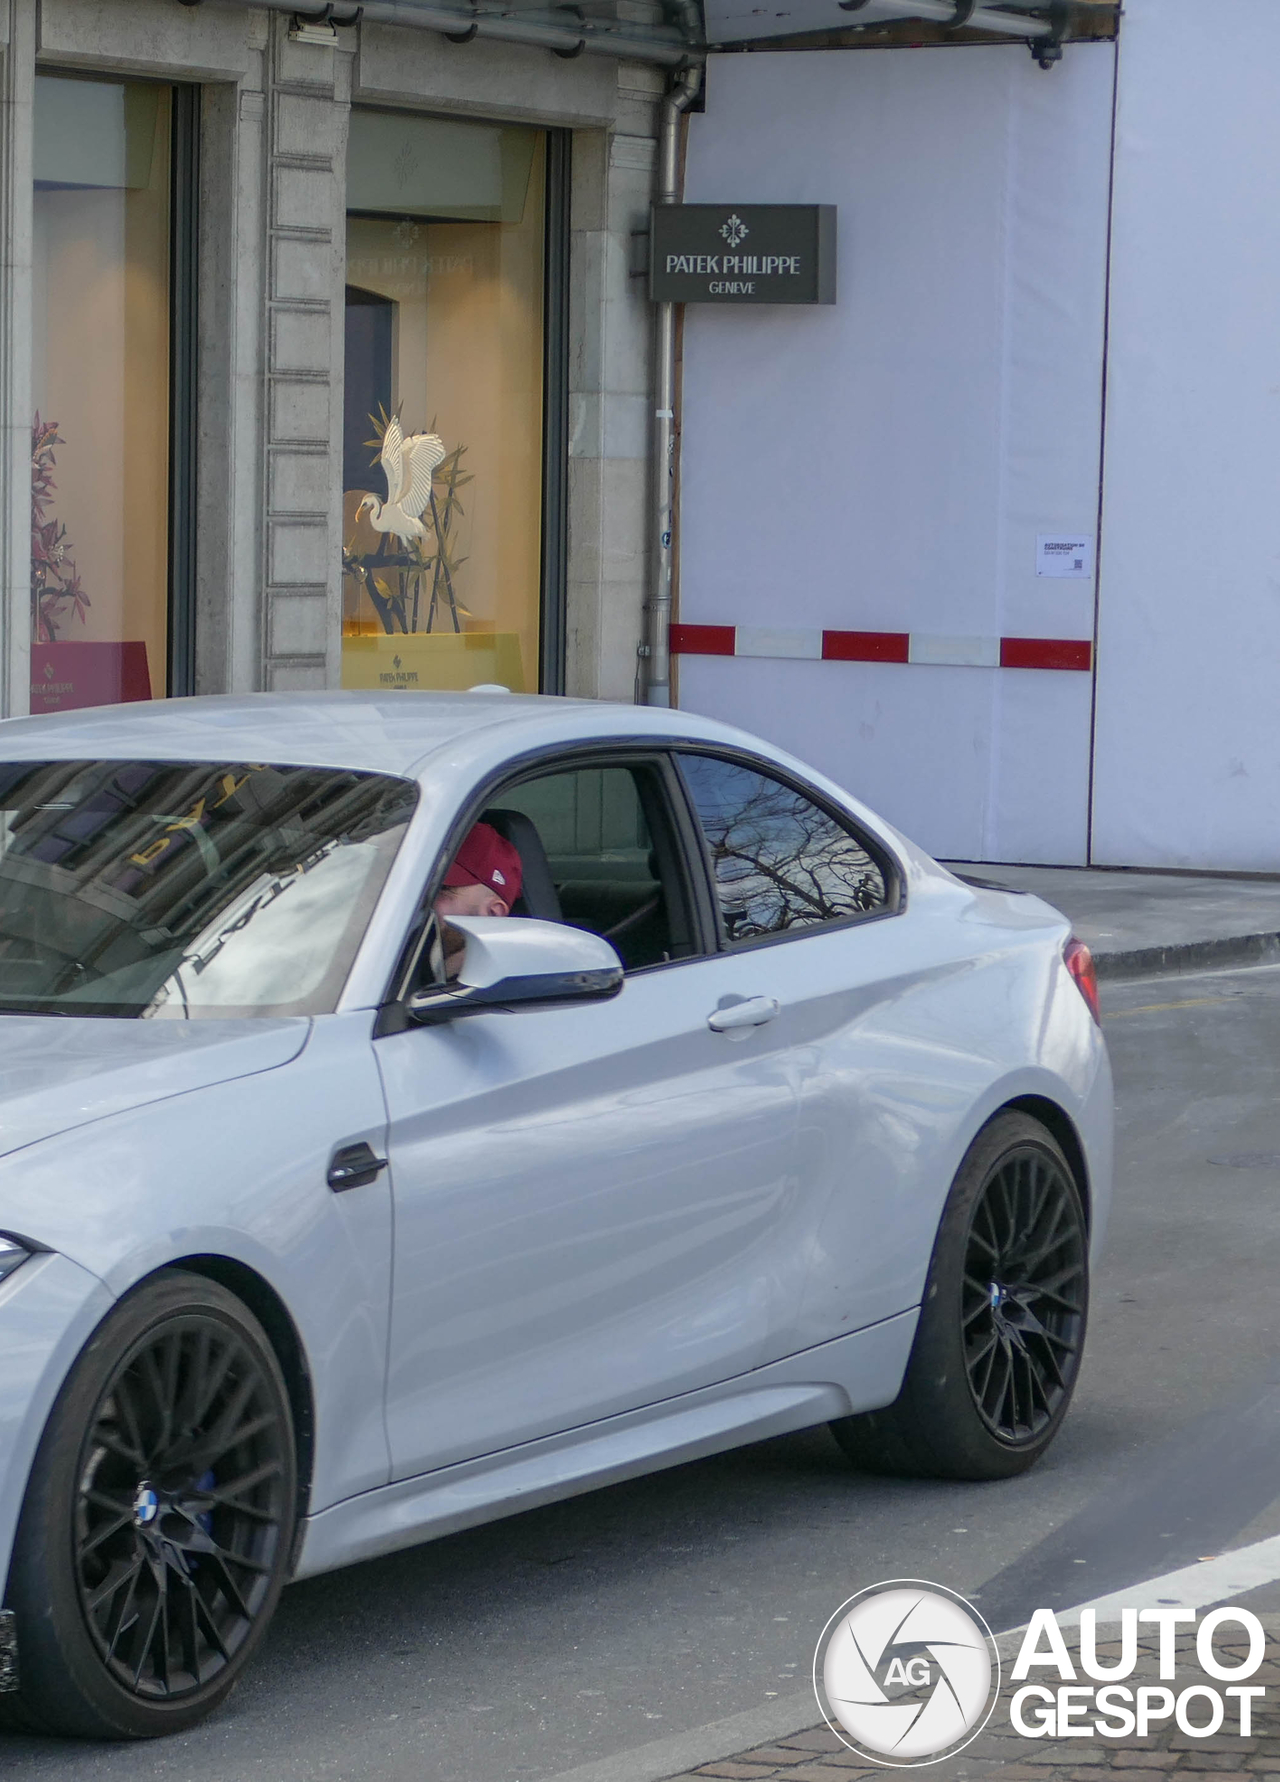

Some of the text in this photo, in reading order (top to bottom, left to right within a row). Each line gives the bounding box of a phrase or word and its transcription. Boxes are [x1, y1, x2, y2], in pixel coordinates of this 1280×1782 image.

[666, 255, 800, 275] PATEK PHILIPPE
[709, 281, 755, 294] GENEVE
[380, 672, 418, 683] PATEK PHILIPPE
